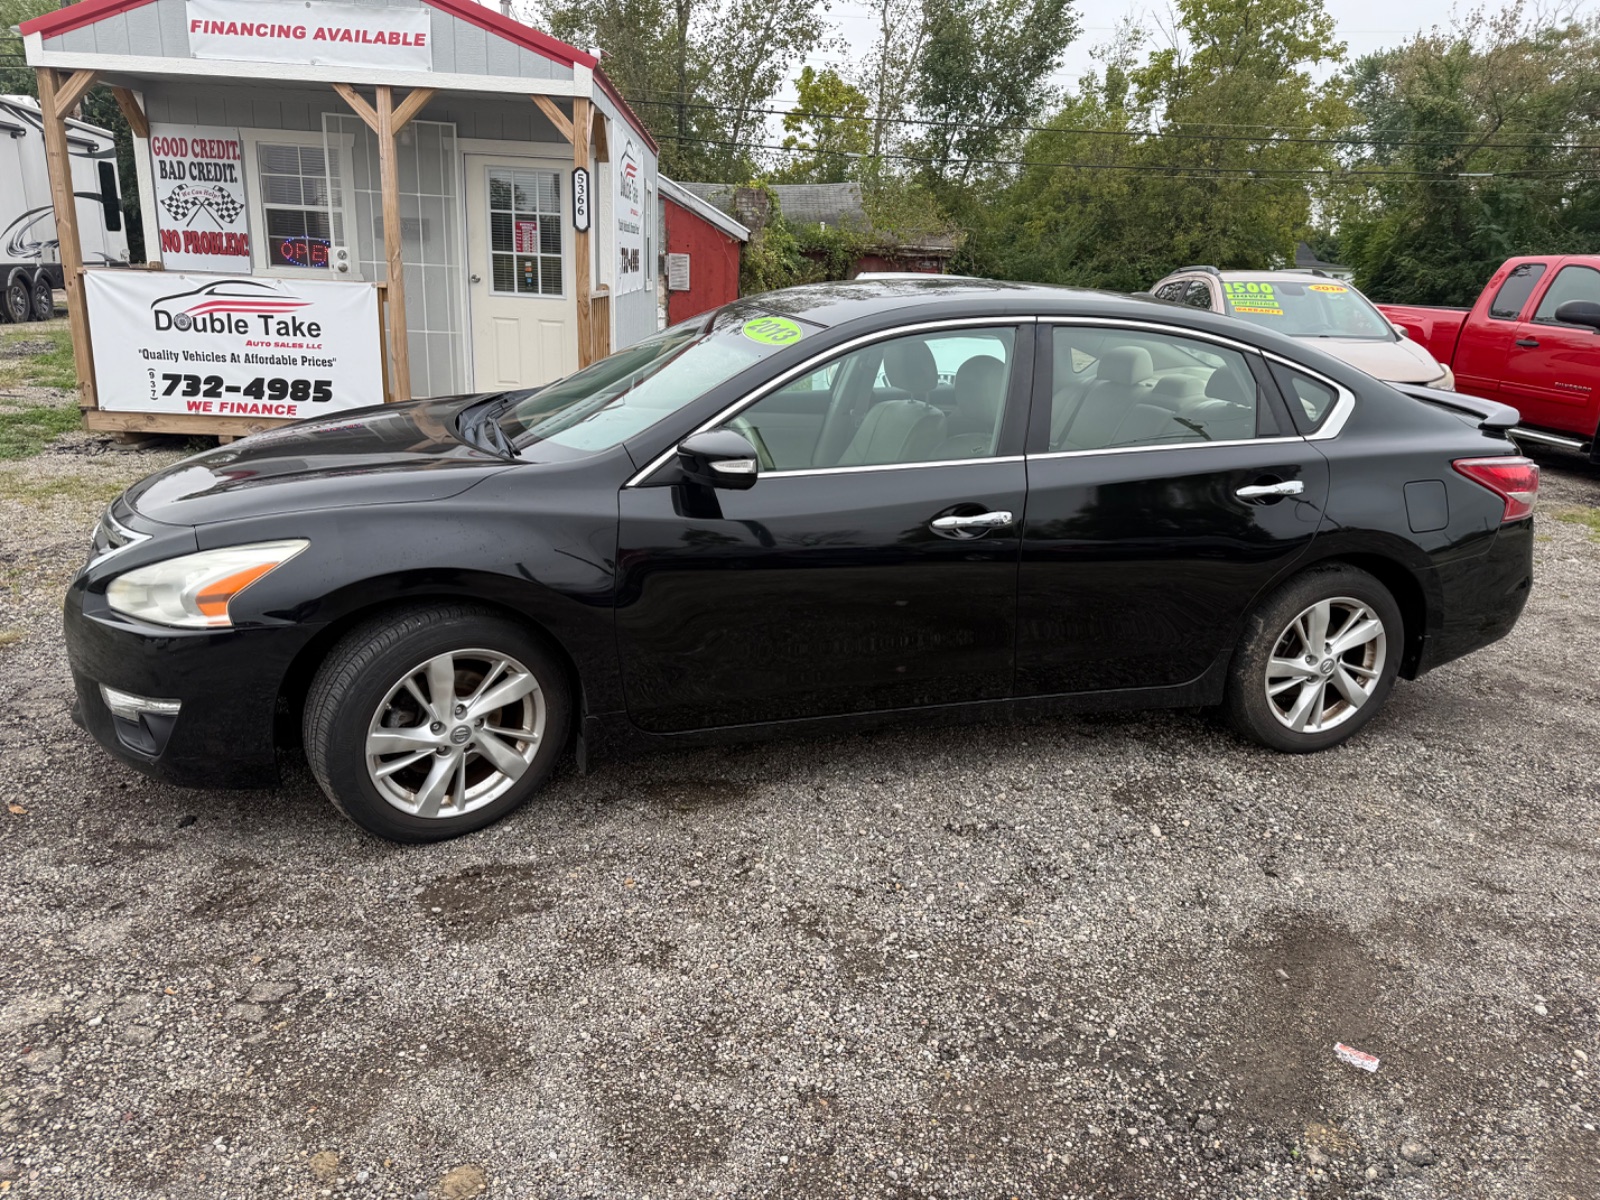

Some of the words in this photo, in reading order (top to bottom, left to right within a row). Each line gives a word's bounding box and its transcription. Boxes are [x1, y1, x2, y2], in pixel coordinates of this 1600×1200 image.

[190, 19, 307, 40] FINANCING
[312, 27, 427, 47] AVAILABLE
[152, 136, 188, 157] GOOD
[191, 138, 241, 161] CREDIT.
[159, 160, 186, 180] BAD
[189, 162, 238, 183] CREDIT.
[181, 190, 191, 198] We
[577, 173, 585, 216] 5366
[160, 229, 181, 254] NO
[182, 230, 250, 257] PROBLEM!
[1223, 282, 1274, 294] 1500
[154, 309, 249, 335] Double
[257, 314, 322, 338] Take
[746, 320, 798, 341] 2013
[246, 339, 271, 348] AUTO
[274, 341, 304, 349] SALES
[138, 349, 179, 363] "Quality
[183, 350, 227, 363] Vehicles
[230, 352, 241, 363] At
[243, 353, 298, 366] Affordable
[301, 356, 337, 368] Prices"
[162, 373, 333, 402] 732-4985
[186, 400, 213, 413] WE
[219, 402, 297, 416] FINANCE
